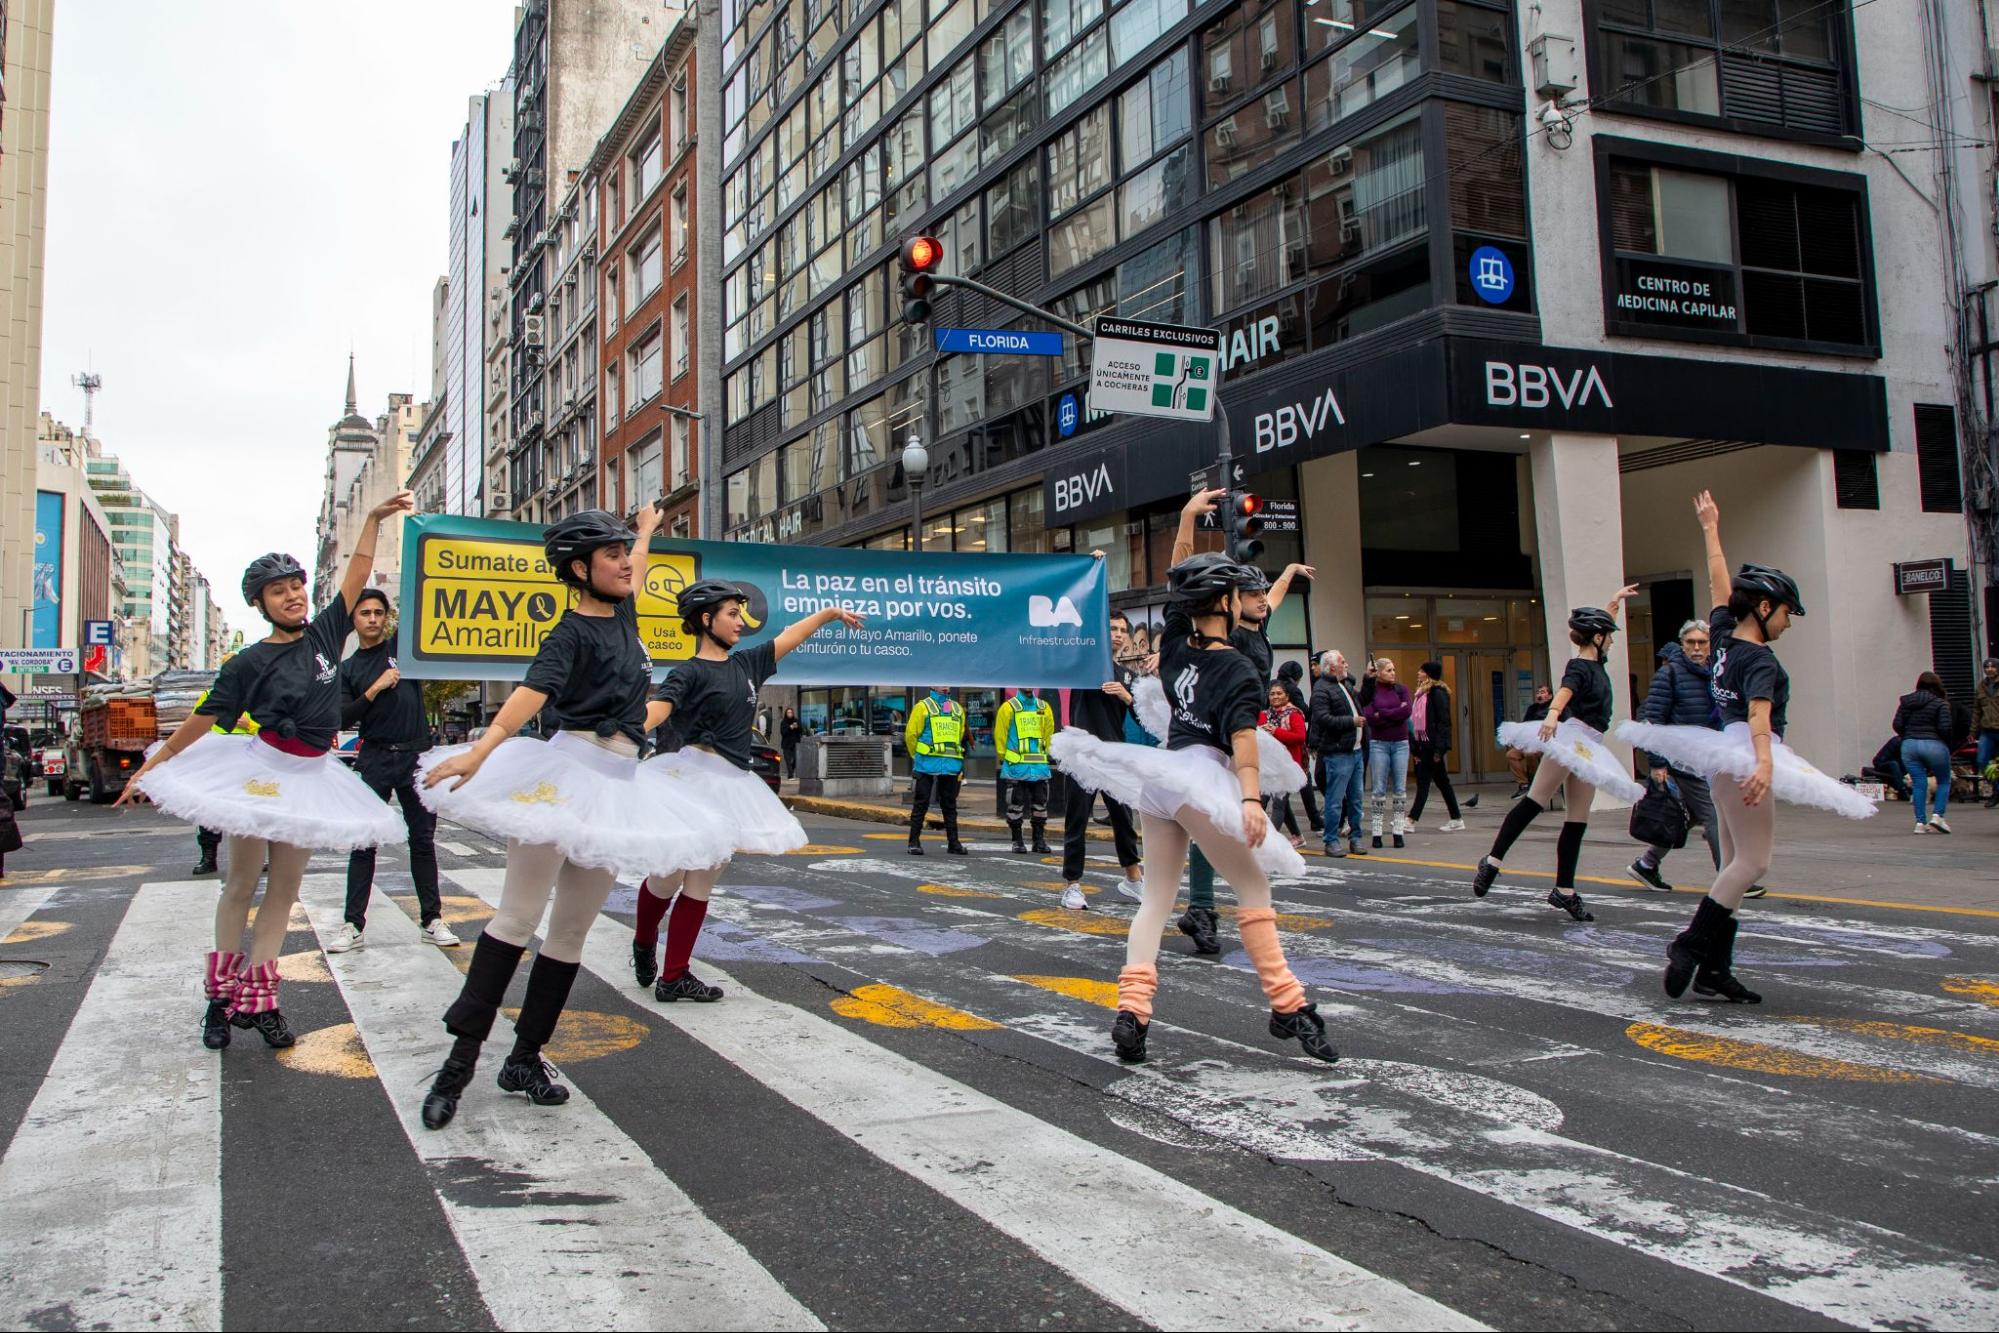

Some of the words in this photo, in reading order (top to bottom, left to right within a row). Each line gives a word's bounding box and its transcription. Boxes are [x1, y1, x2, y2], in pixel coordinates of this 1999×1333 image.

[1638, 276, 1690, 294] CENTRO
[1693, 282, 1711, 297] DE
[1682, 301, 1737, 319] CAPILAR
[969, 334, 1029, 349] FLORIDA
[1101, 323, 1151, 337] CARRILES
[1153, 329, 1214, 344] EXCLUSIVOS
[1218, 315, 1281, 372] HAIR
[1096, 368, 1150, 382] ÚNICAMENTE
[1107, 360, 1141, 371] ACCESO
[1104, 380, 1149, 392] COCHERAS
[1485, 361, 1614, 411] BBVA
[1254, 387, 1345, 453] BBVA
[1054, 462, 1113, 512] BBVA
[1270, 502, 1295, 510] Florida
[779, 511, 802, 540] HAIR
[438, 550, 529, 572] Sumate
[782, 569, 810, 590] La
[816, 574, 857, 594] paz
[861, 577, 889, 593] en
[894, 574, 914, 594] el
[918, 575, 1002, 597] tránsito
[1905, 571, 1940, 583] BANELCO
[433, 588, 557, 622] MAYO
[784, 594, 881, 616] empieza
[886, 600, 923, 620] por
[927, 601, 972, 619] vos.
[1028, 594, 1083, 628] BA
[90, 622, 109, 644] E
[653, 627, 676, 638] Usá
[834, 627, 847, 640] al
[849, 628, 882, 643] Mayo
[884, 629, 936, 644] Amarillo,
[938, 631, 978, 645] ponete
[1019, 634, 1096, 646] Infraestructura
[647, 640, 683, 650] casco
[796, 641, 846, 655] cinturón
[849, 645, 856, 655] o
[860, 643, 872, 655] tu
[874, 645, 913, 656] casco.
[60, 660, 70, 671] E
